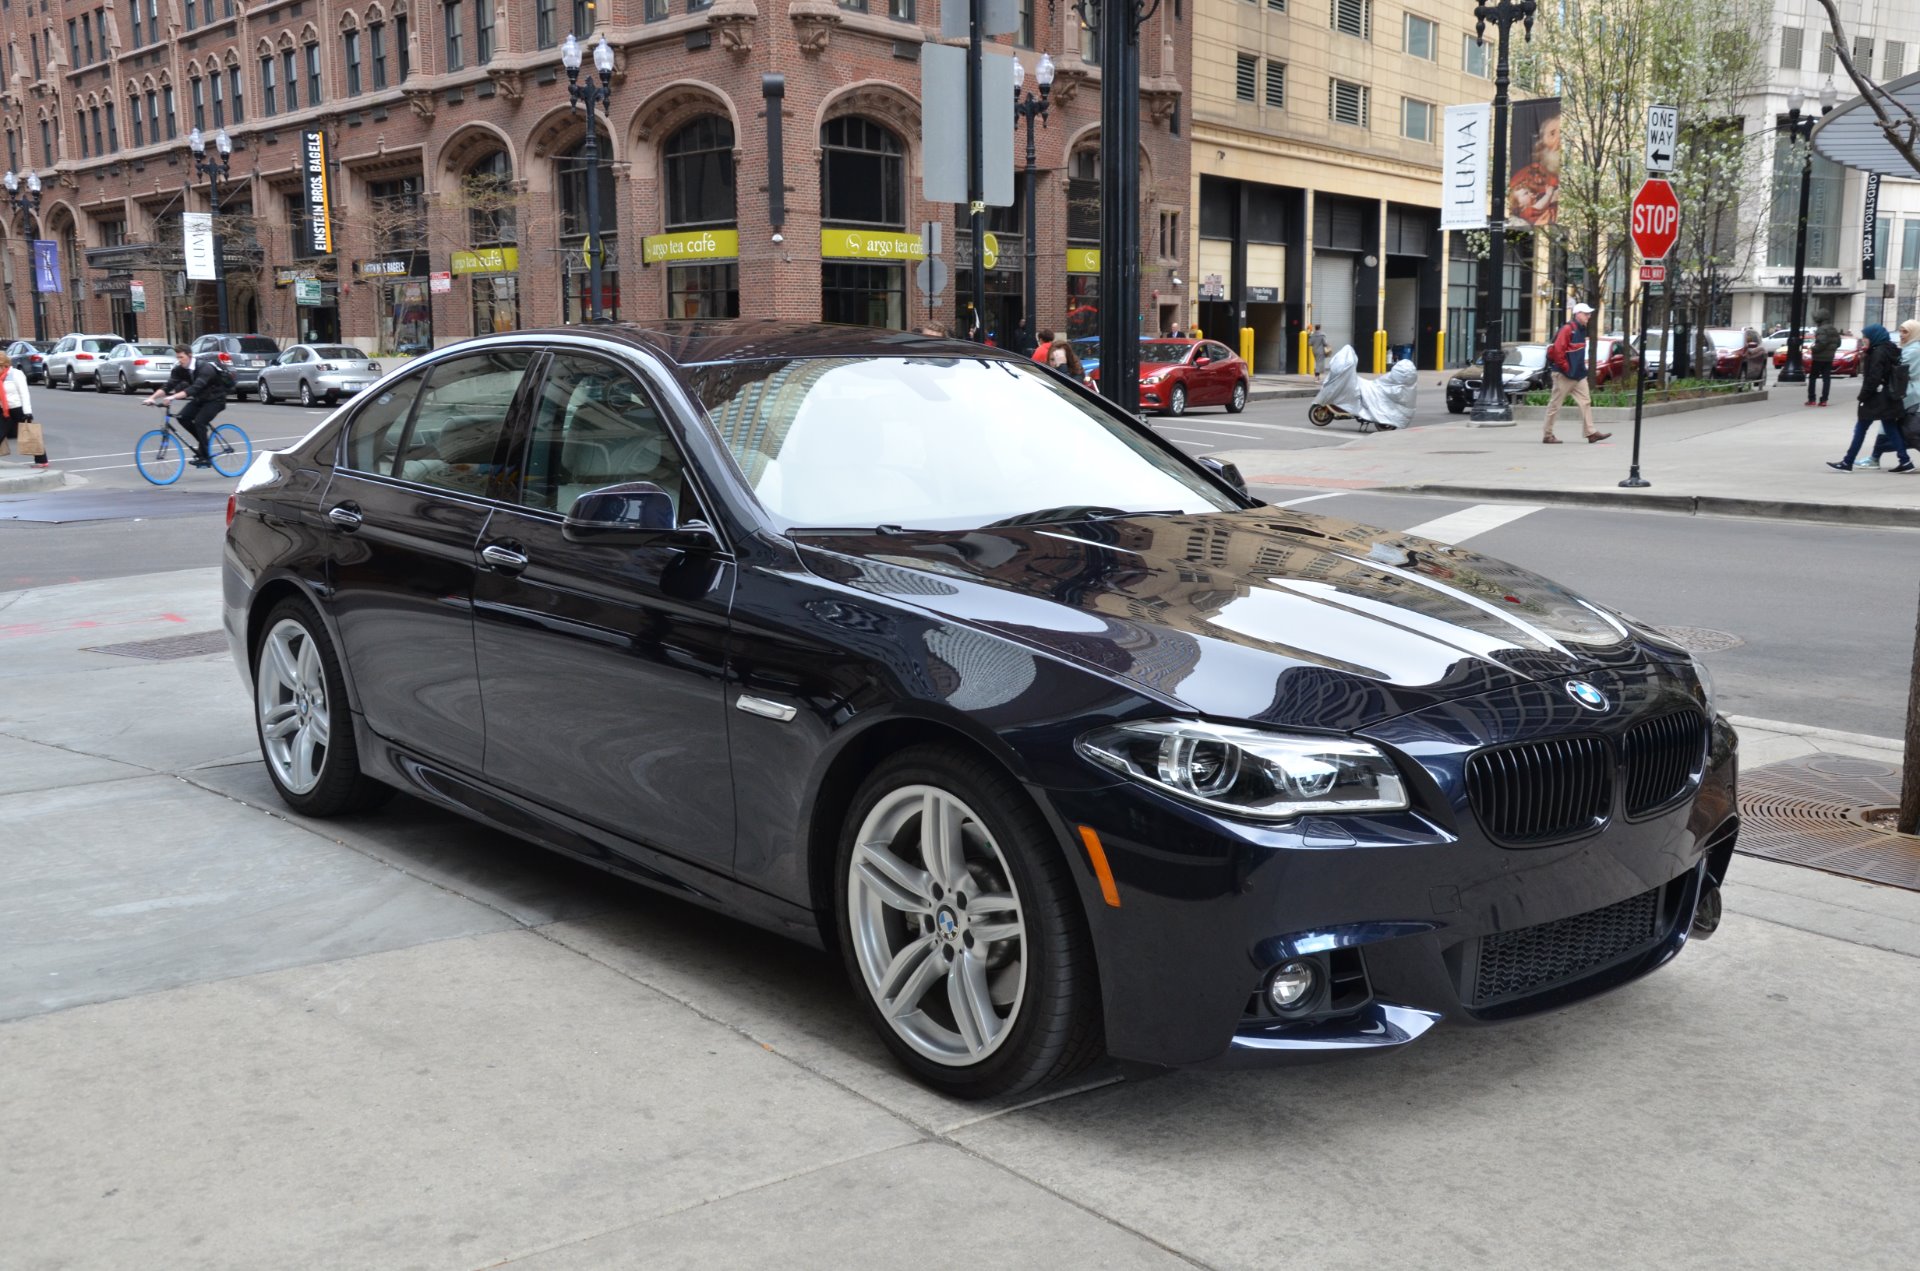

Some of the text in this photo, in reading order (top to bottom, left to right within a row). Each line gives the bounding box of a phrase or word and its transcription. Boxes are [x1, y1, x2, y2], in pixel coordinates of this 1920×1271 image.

[1652, 111, 1674, 128] ONE
[1650, 130, 1674, 146] WAY
[307, 133, 322, 172] BAGELS
[1455, 120, 1477, 205] LUMA
[312, 205, 327, 251] EINSTEIN
[1634, 203, 1676, 235] STOP
[1863, 172, 1877, 261] ORDSTROM rack
[652, 232, 716, 260] argo tea café
[867, 236, 923, 257] argo tea caf
[387, 262, 405, 273] BAGELS
[479, 250, 502, 267] café
[1641, 268, 1663, 280] ALL WAY
